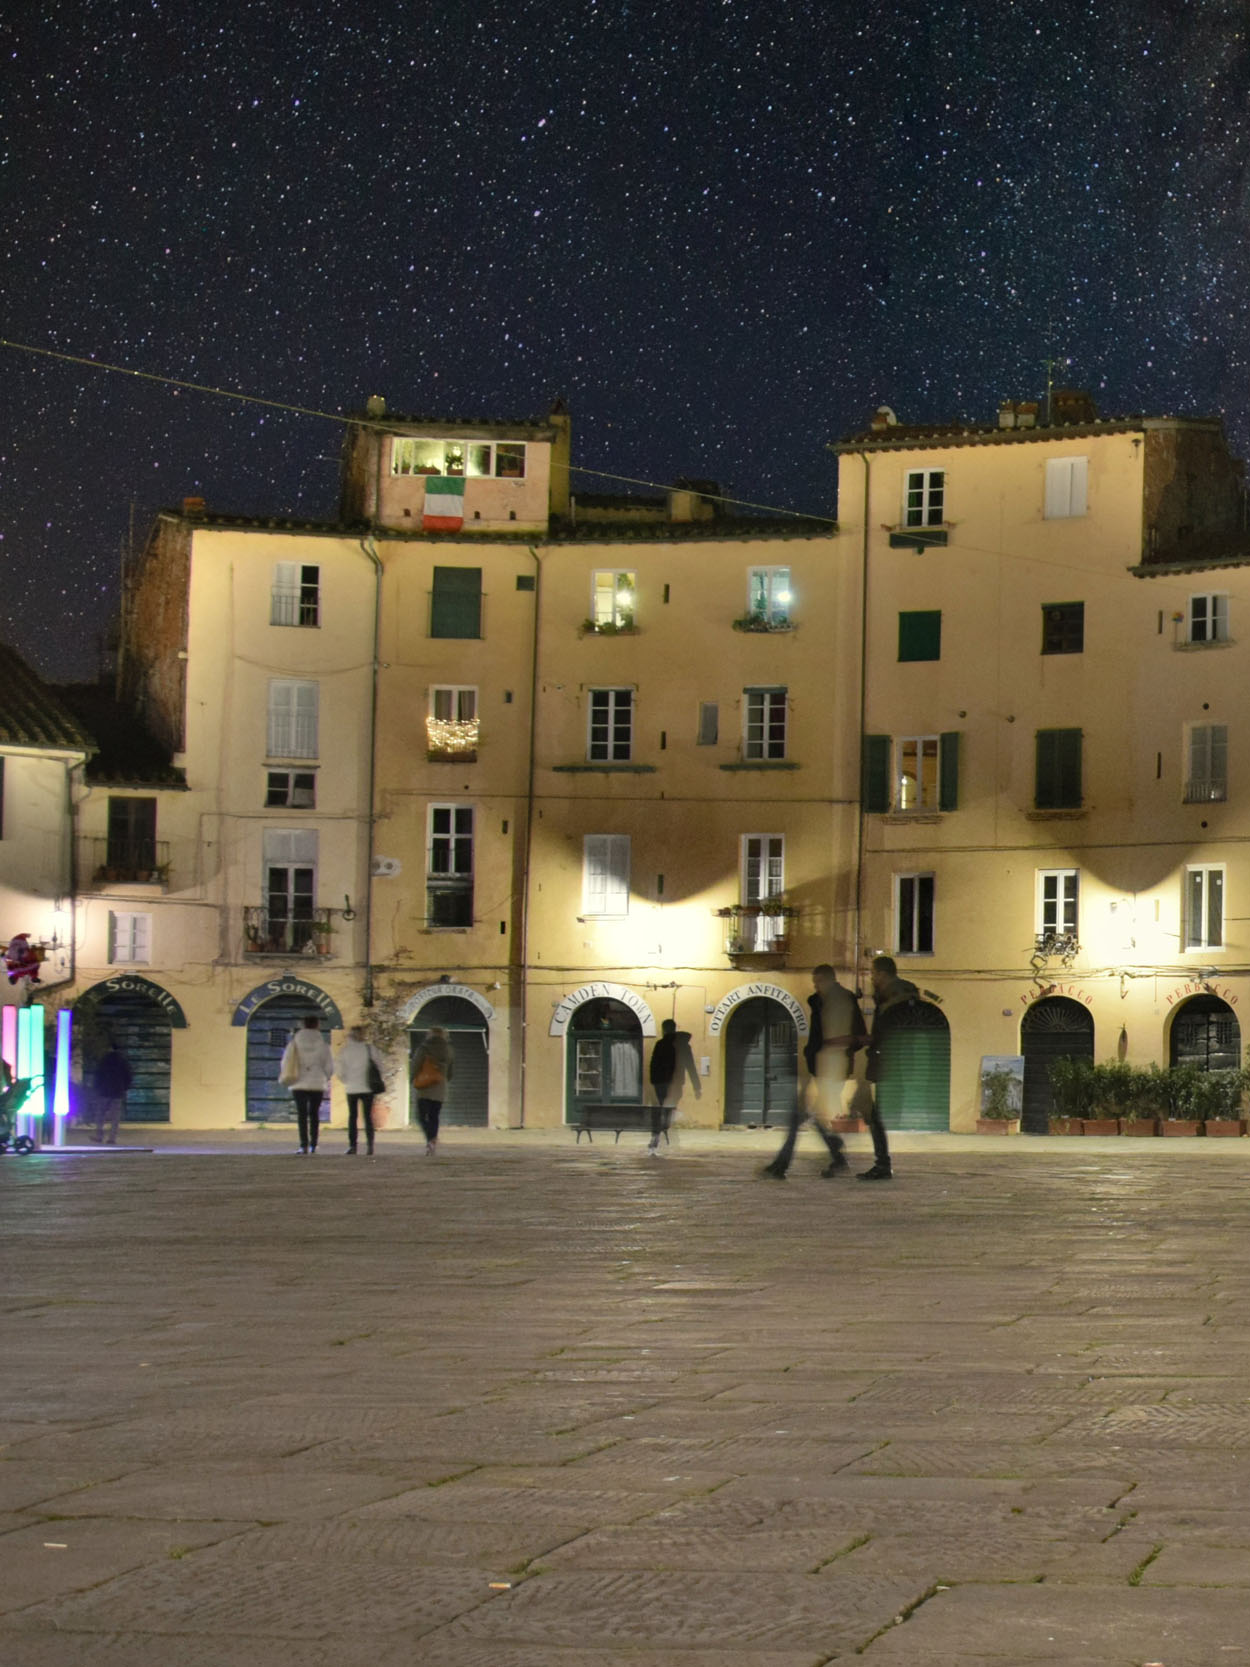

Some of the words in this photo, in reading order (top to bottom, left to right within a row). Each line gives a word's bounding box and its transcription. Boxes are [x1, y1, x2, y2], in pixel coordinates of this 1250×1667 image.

[554, 983, 610, 1024] CAMDEN
[620, 987, 653, 1024] TOWN
[711, 991, 741, 1031] OTTART
[747, 984, 808, 1031] ANFITEATRO
